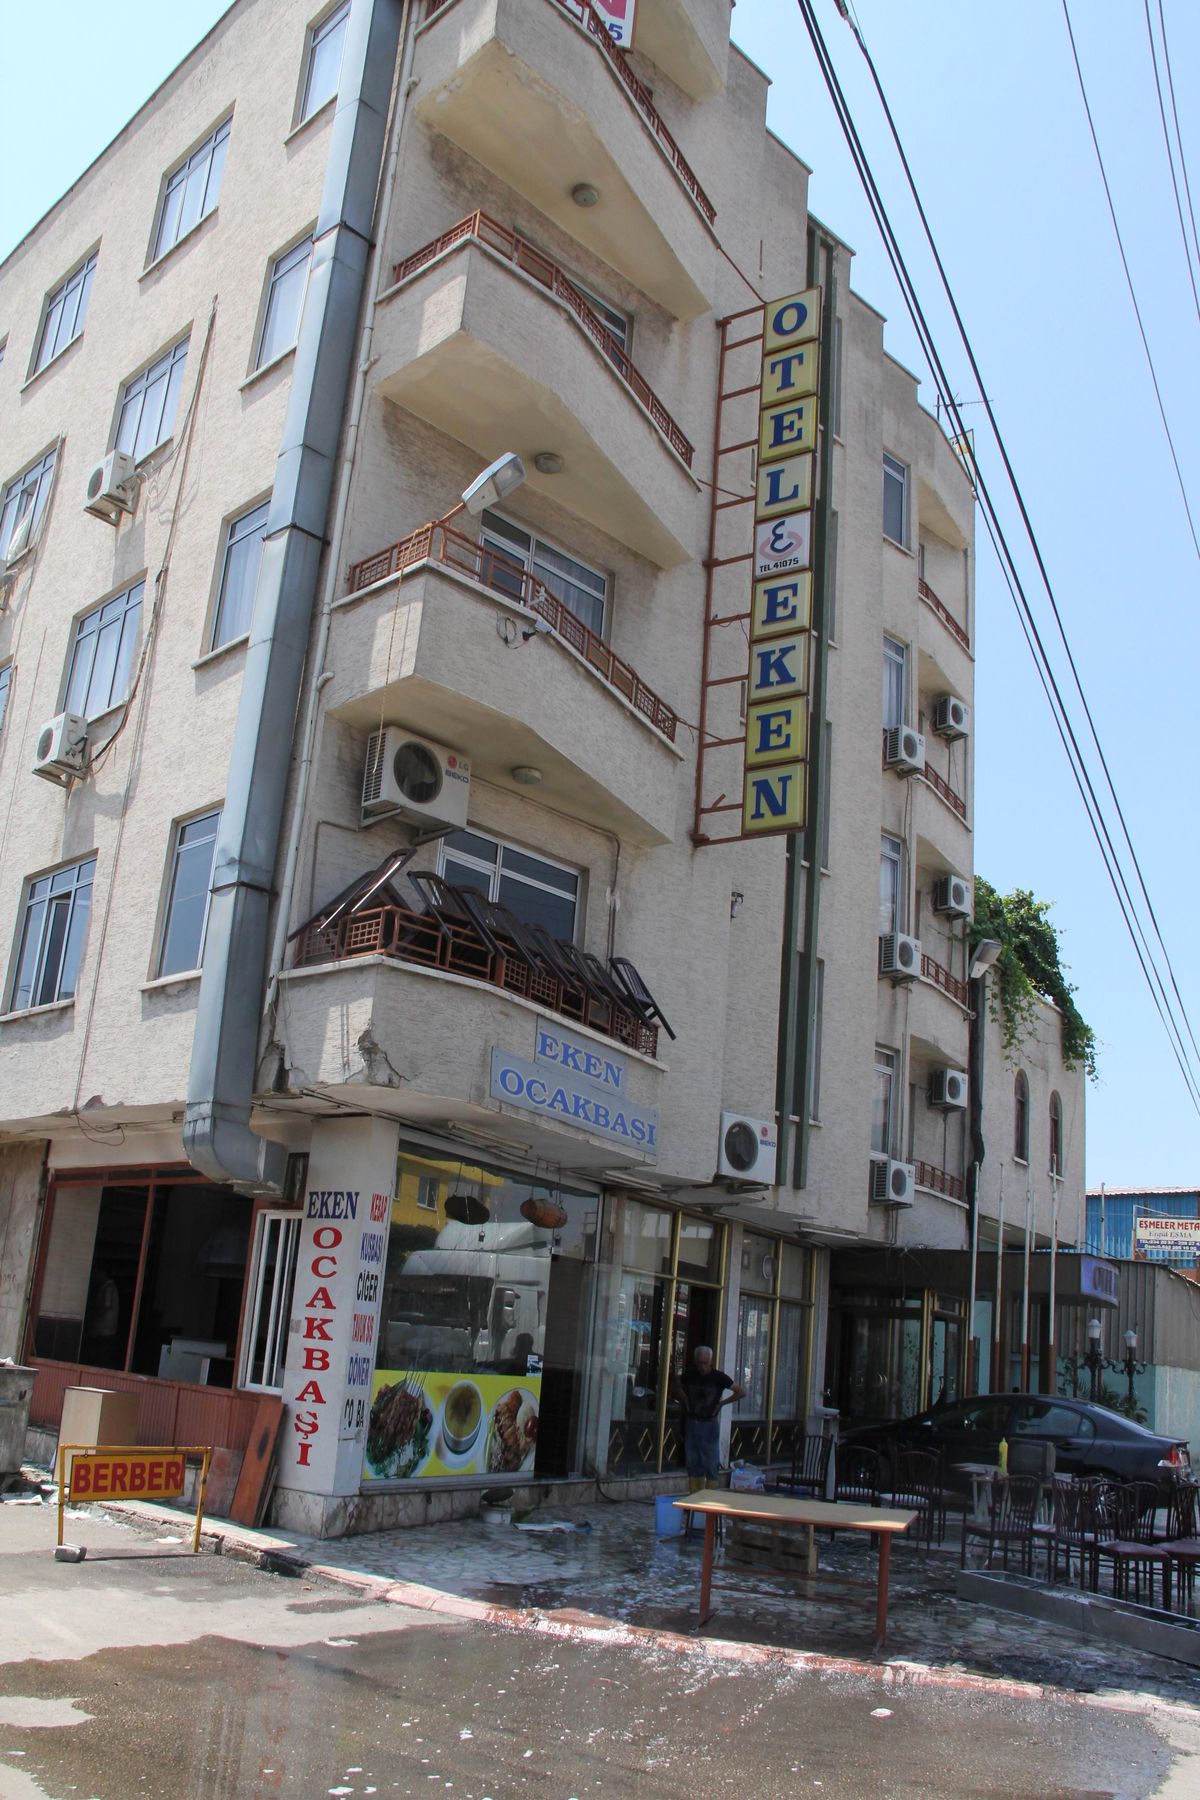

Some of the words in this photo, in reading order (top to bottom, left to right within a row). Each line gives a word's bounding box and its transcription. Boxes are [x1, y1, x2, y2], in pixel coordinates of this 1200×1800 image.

[764, 301, 808, 507] OTEL
[773, 557, 799, 569] 41075
[751, 582, 798, 821] EKEN
[537, 1031, 623, 1088] EKEN
[500, 1068, 657, 1146] OCAKBAŞI
[306, 1191, 360, 1220] EKEN
[370, 1193, 388, 1223] KEBAP
[1138, 1220, 1176, 1231] EŞMELER
[357, 1269, 379, 1303] CİĞER
[293, 1226, 343, 1467] OCAKBAŞI
[347, 1353, 370, 1386] DÖNER
[73, 1461, 181, 1494] BERBER
